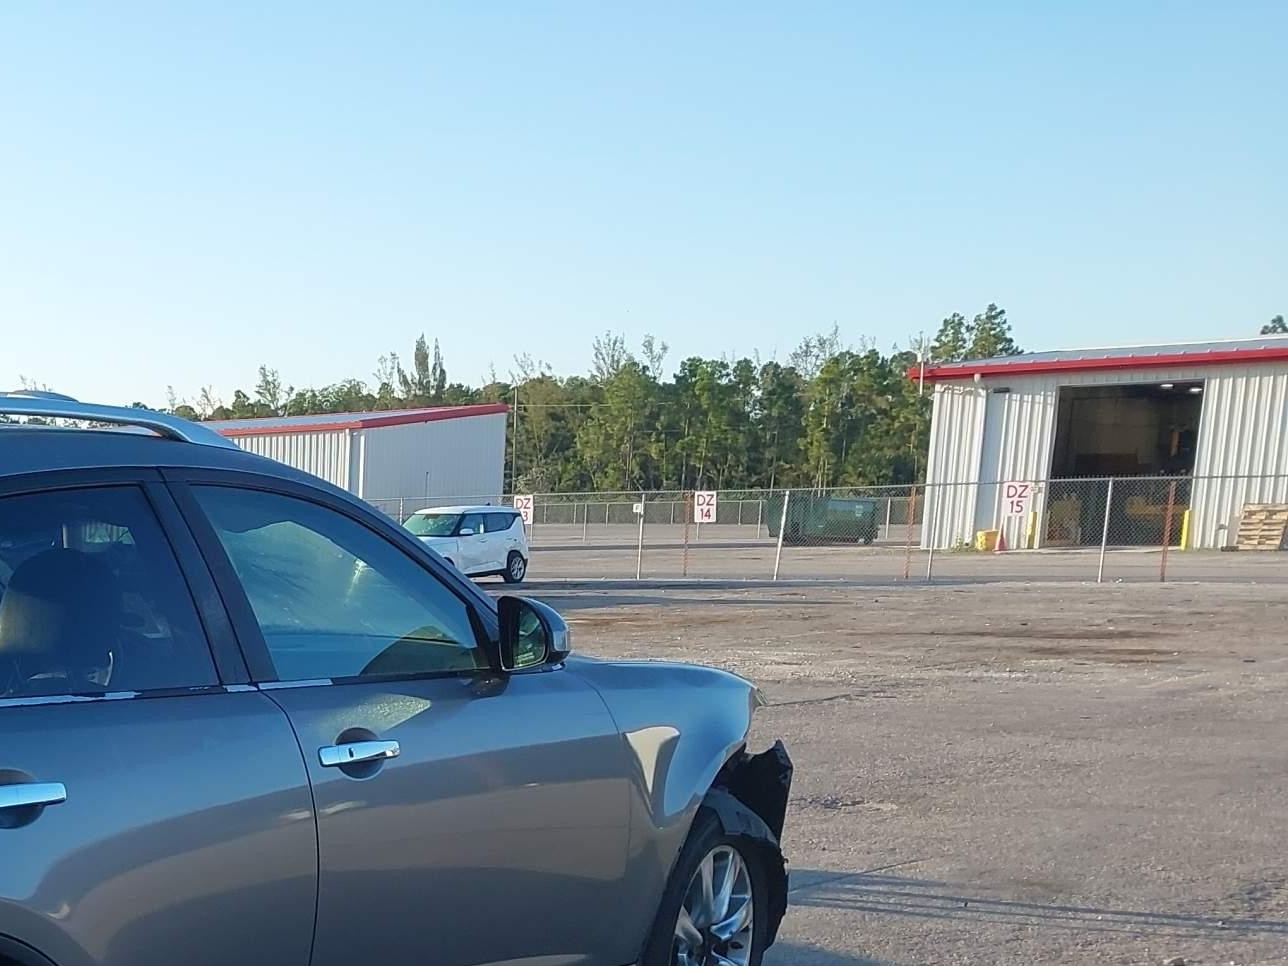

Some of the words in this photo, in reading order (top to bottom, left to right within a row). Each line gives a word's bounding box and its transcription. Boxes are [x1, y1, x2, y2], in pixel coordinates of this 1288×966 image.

[1007, 484, 1029, 498] DZ
[515, 497, 531, 509] DZ
[696, 494, 715, 506] DZ
[1010, 500, 1024, 513] 15
[700, 508, 712, 520] 14
